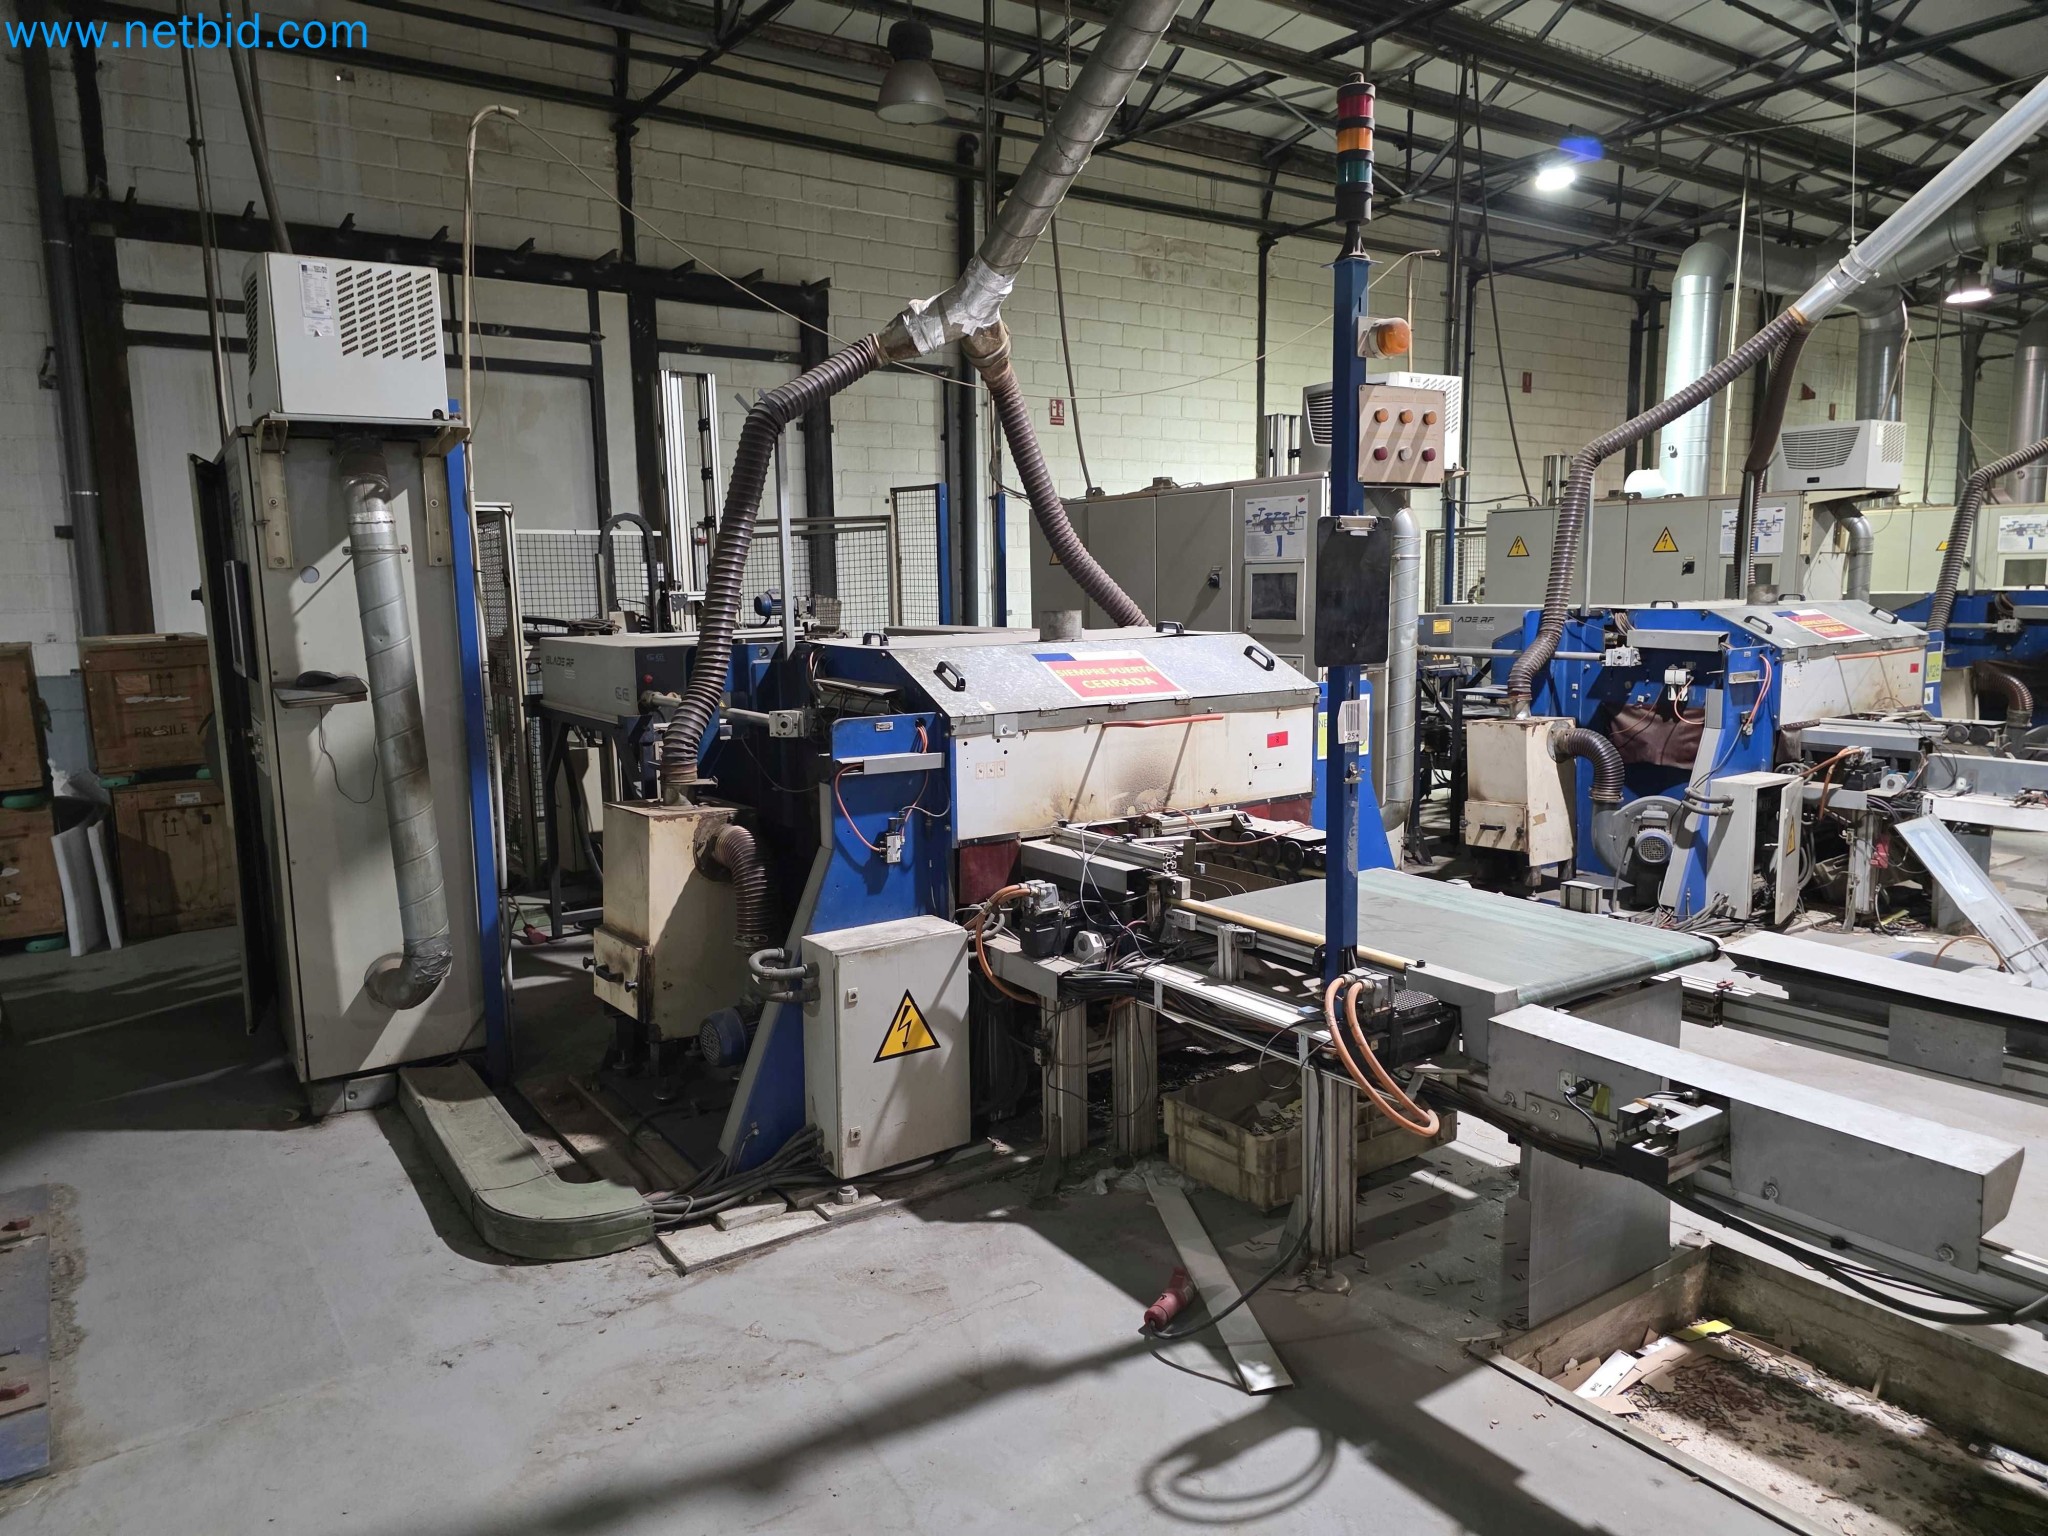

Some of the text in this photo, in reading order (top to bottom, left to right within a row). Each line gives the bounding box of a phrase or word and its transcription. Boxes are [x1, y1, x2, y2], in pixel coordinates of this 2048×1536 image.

[1056, 665, 1156, 677] SIEMPRE PUERTA
[1082, 677, 1158, 689] CERRADA
